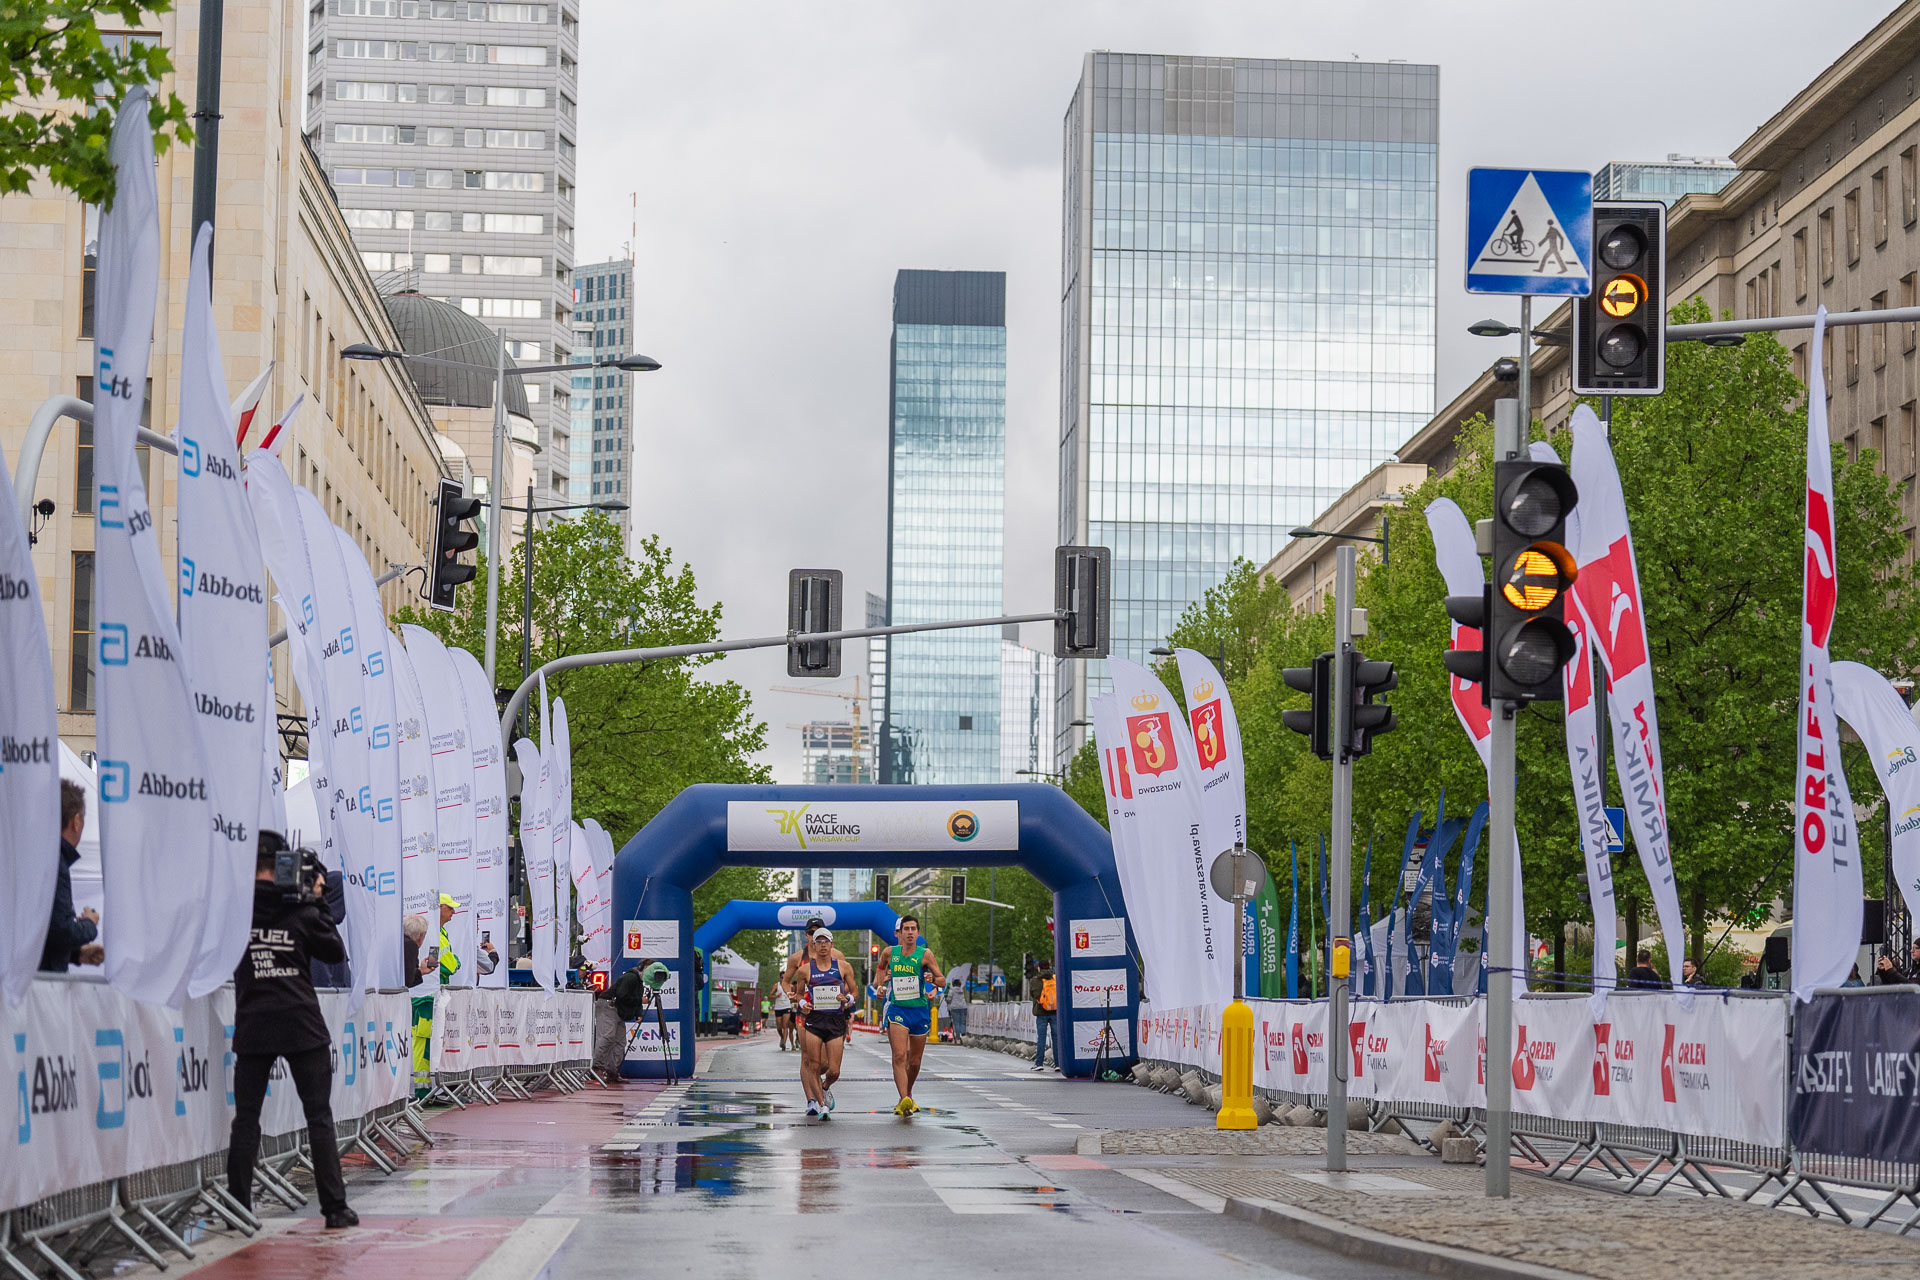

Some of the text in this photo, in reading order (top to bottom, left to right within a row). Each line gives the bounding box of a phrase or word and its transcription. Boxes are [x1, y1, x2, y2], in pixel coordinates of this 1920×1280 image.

[198, 572, 263, 604] Abbott
[138, 772, 208, 800] Abbott
[805, 814, 838, 824] RACE
[805, 825, 860, 835] WALKING
[250, 929, 294, 945] FUEL
[251, 951, 276, 960] FUEL
[253, 960, 274, 969] THE
[893, 965, 915, 973] BRASIL
[254, 967, 300, 979] MUSCLES
[1530, 1041, 1556, 1060] ORLEN
[1678, 1042, 1706, 1065] ORLEN
